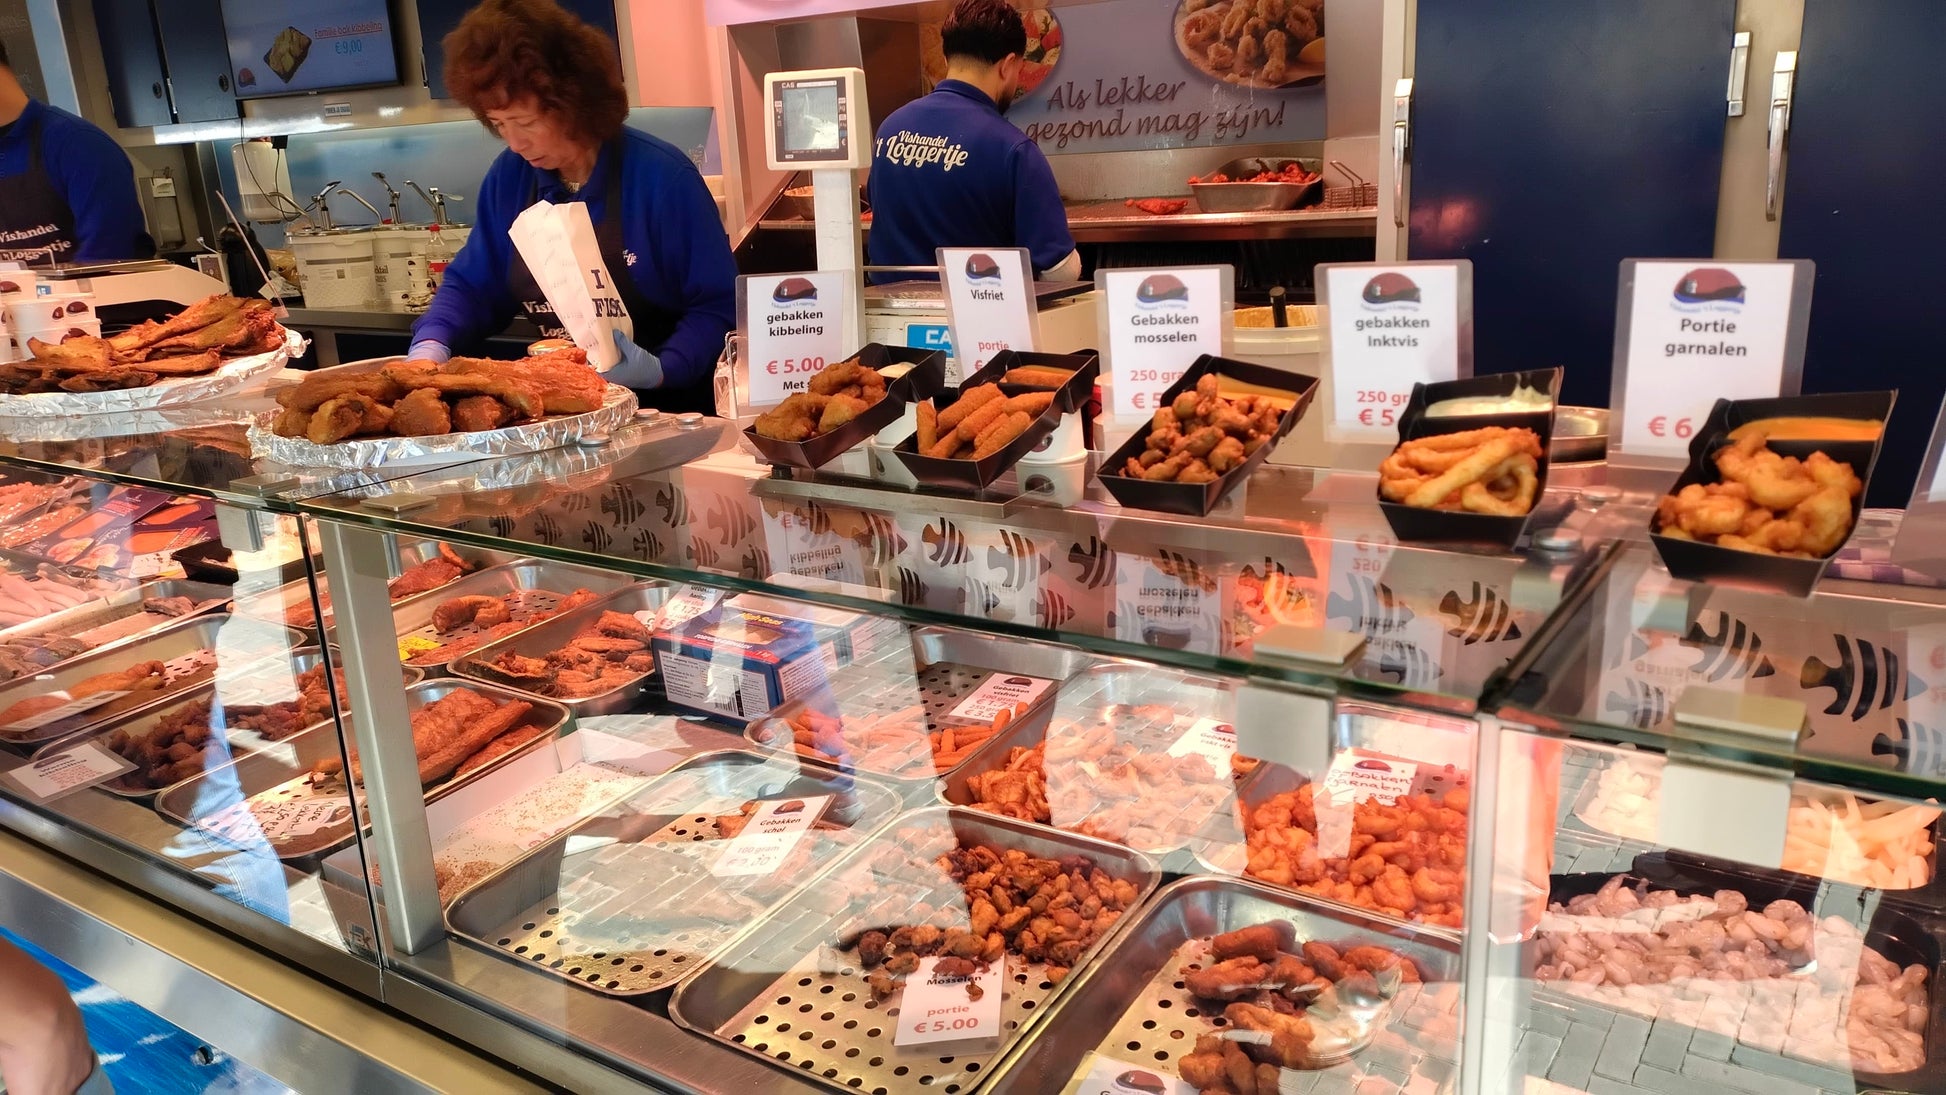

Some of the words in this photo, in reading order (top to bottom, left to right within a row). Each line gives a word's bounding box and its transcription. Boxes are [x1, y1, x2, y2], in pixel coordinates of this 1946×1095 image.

[1048, 81, 1091, 110] Als
[1096, 75, 1186, 107] lekker
[1026, 108, 1131, 148] gezond
[1137, 110, 1209, 141] mag
[898, 130, 948, 147] Vishandel
[886, 135, 969, 172] Loggertje
[590, 269, 605, 290] I
[970, 289, 1004, 301] Visfriet
[766, 310, 824, 324] gebakken
[1131, 313, 1199, 326] Gebakken
[1355, 316, 1430, 331] gebakken
[769, 325, 824, 337] kibbeling
[1680, 318, 1736, 333] Portie
[1134, 332, 1197, 343] mosselen
[1368, 336, 1419, 347] Inktvis
[978, 341, 1010, 352] portie
[1665, 342, 1747, 357] garnalen
[766, 360, 778, 375] €
[783, 356, 825, 374] 5.00
[1130, 370, 1157, 381] 250
[783, 381, 805, 390] Met
[1131, 393, 1145, 409] €
[1357, 391, 1387, 403] 250
[1358, 408, 1373, 426] €
[1648, 416, 1667, 437] €
[760, 818, 801, 826] Gebakken
[927, 976, 982, 986] Mosselen
[927, 1005, 970, 1017] portie
[914, 1022, 927, 1033] €
[932, 1017, 979, 1032] 5.00
